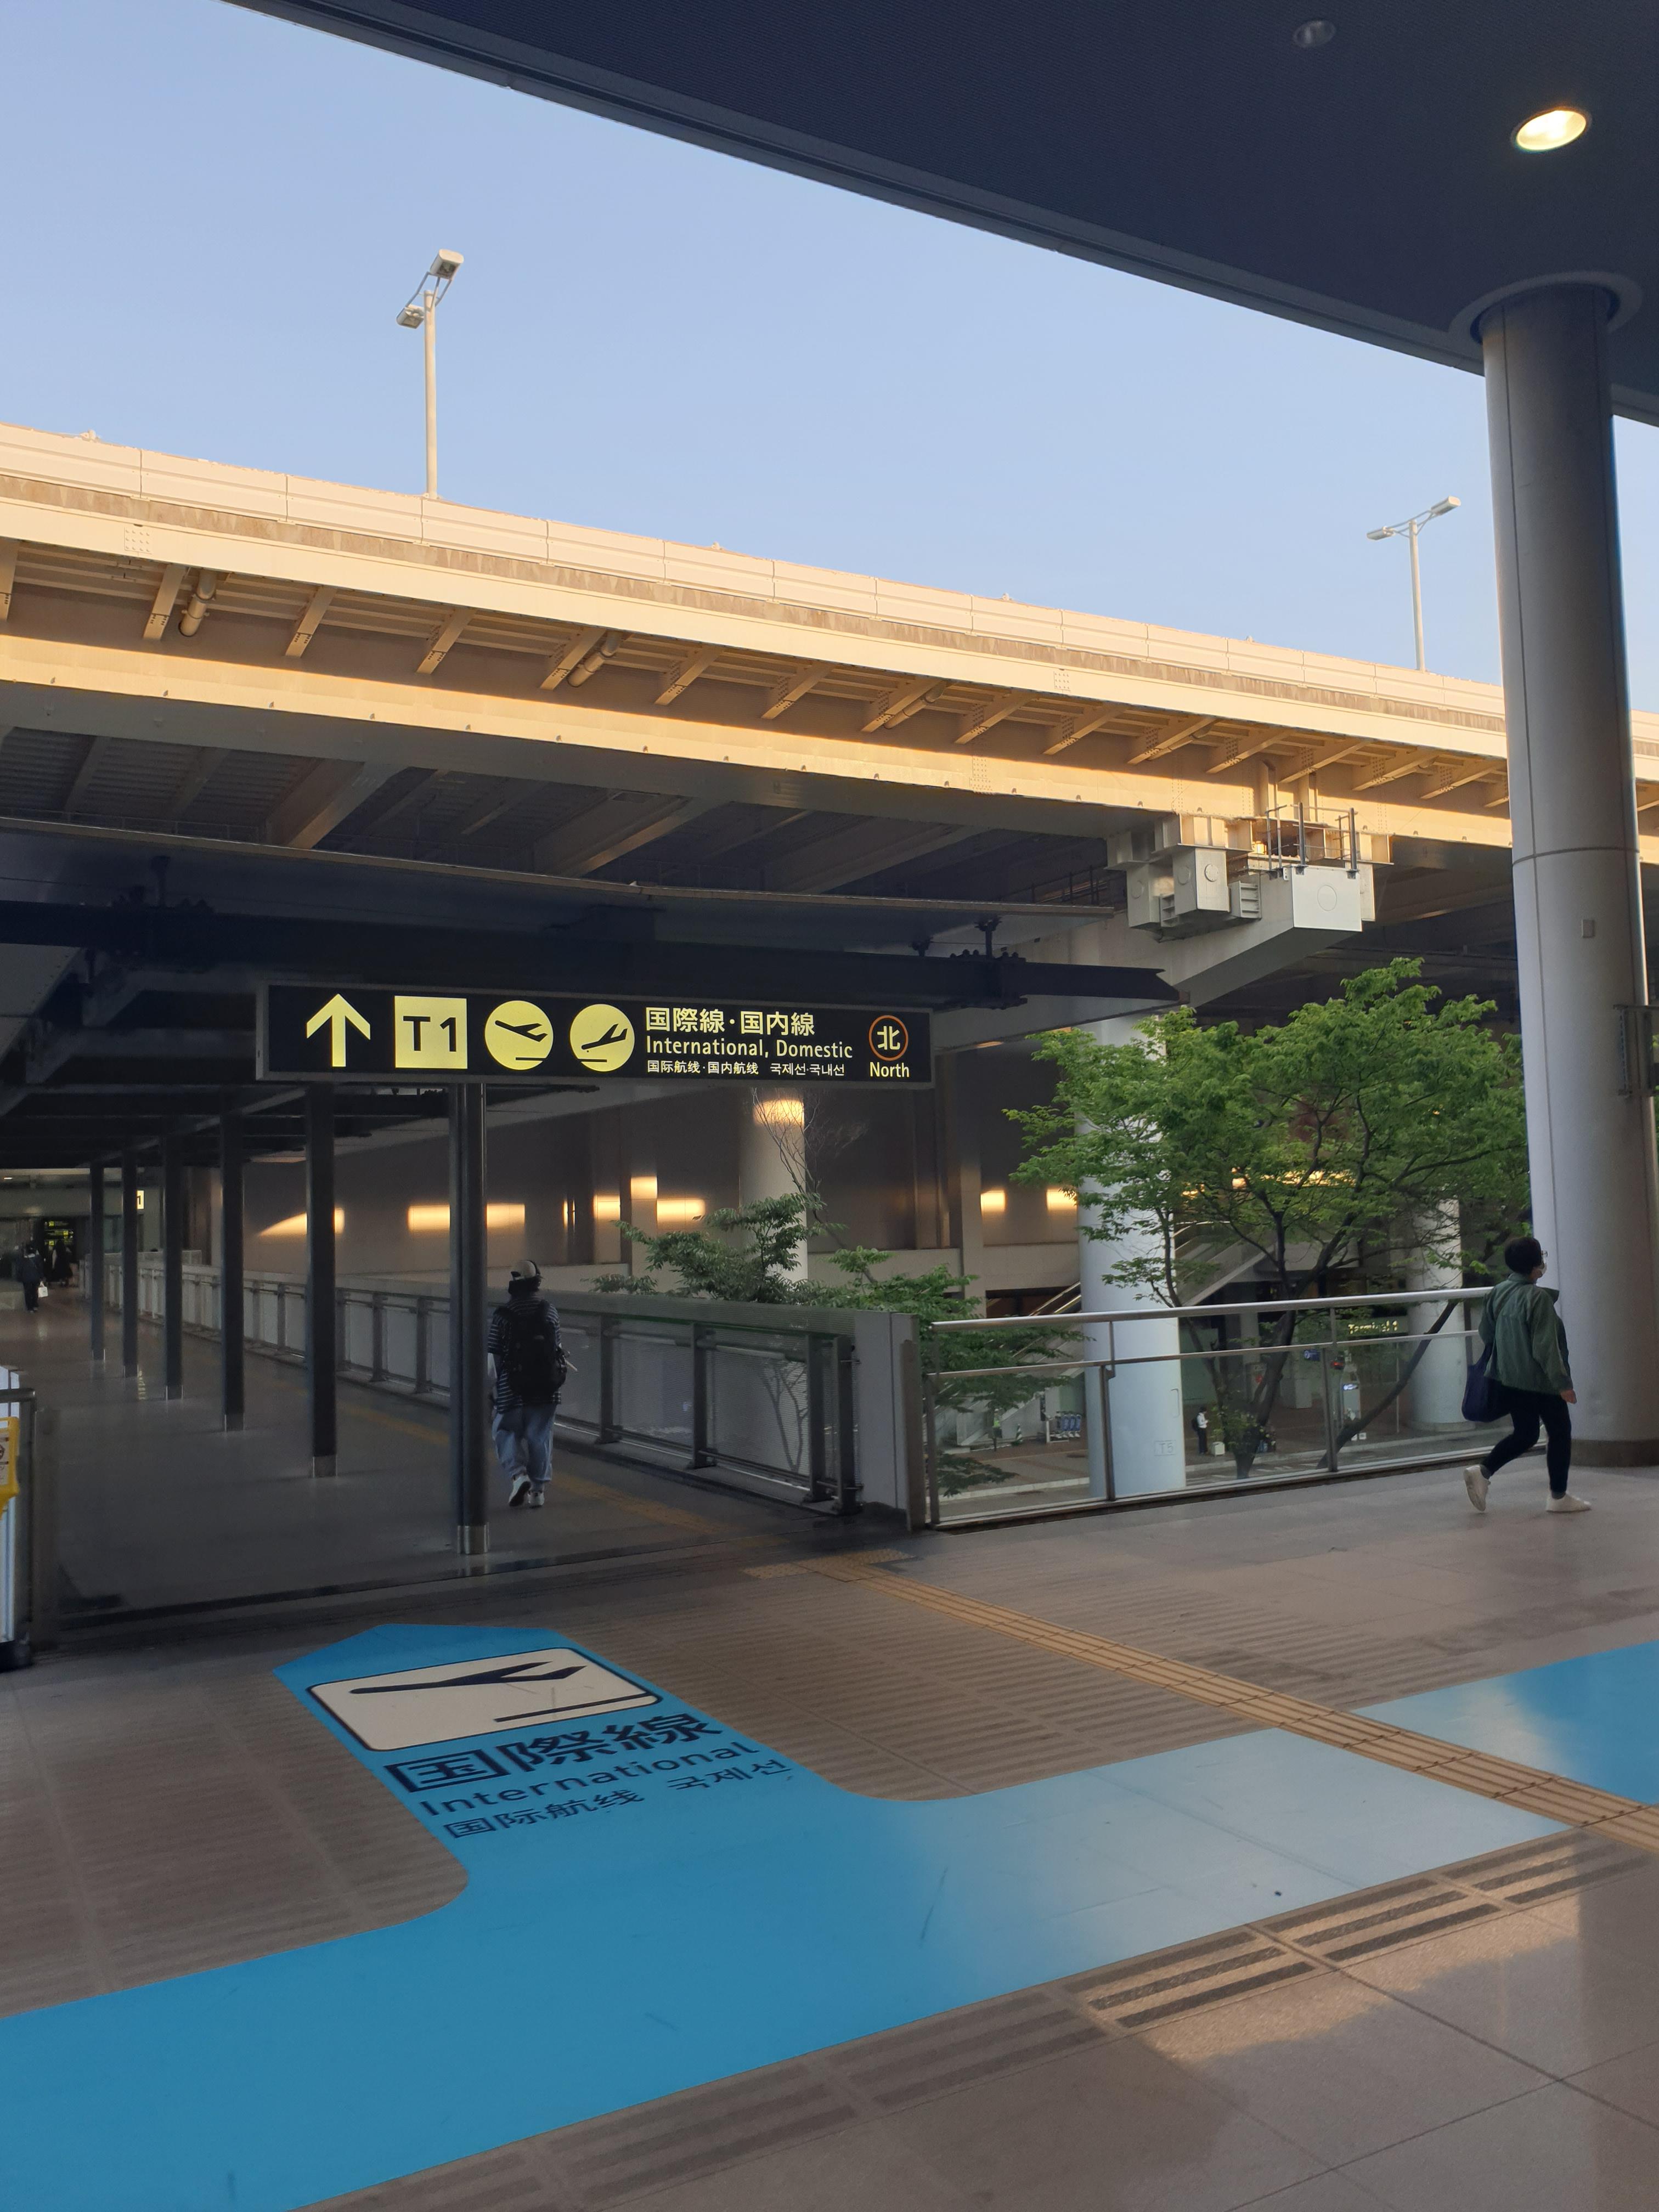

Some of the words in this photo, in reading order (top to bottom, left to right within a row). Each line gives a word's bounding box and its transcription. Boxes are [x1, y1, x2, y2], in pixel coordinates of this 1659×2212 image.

[403, 1015, 457, 1052] T1
[646, 1035, 769, 1058] International,
[776, 1039, 853, 1058] Domestic
[877, 1025, 901, 1051] 北
[869, 1062, 910, 1078] North
[1348, 1320, 1390, 1334] Termial
[1159, 1443, 1173, 1453] T5
[384, 1712, 723, 1793] 国際線
[419, 1741, 760, 1817] International
[443, 1789, 646, 1839] 国际航线
[667, 1758, 792, 1790] 국제선
